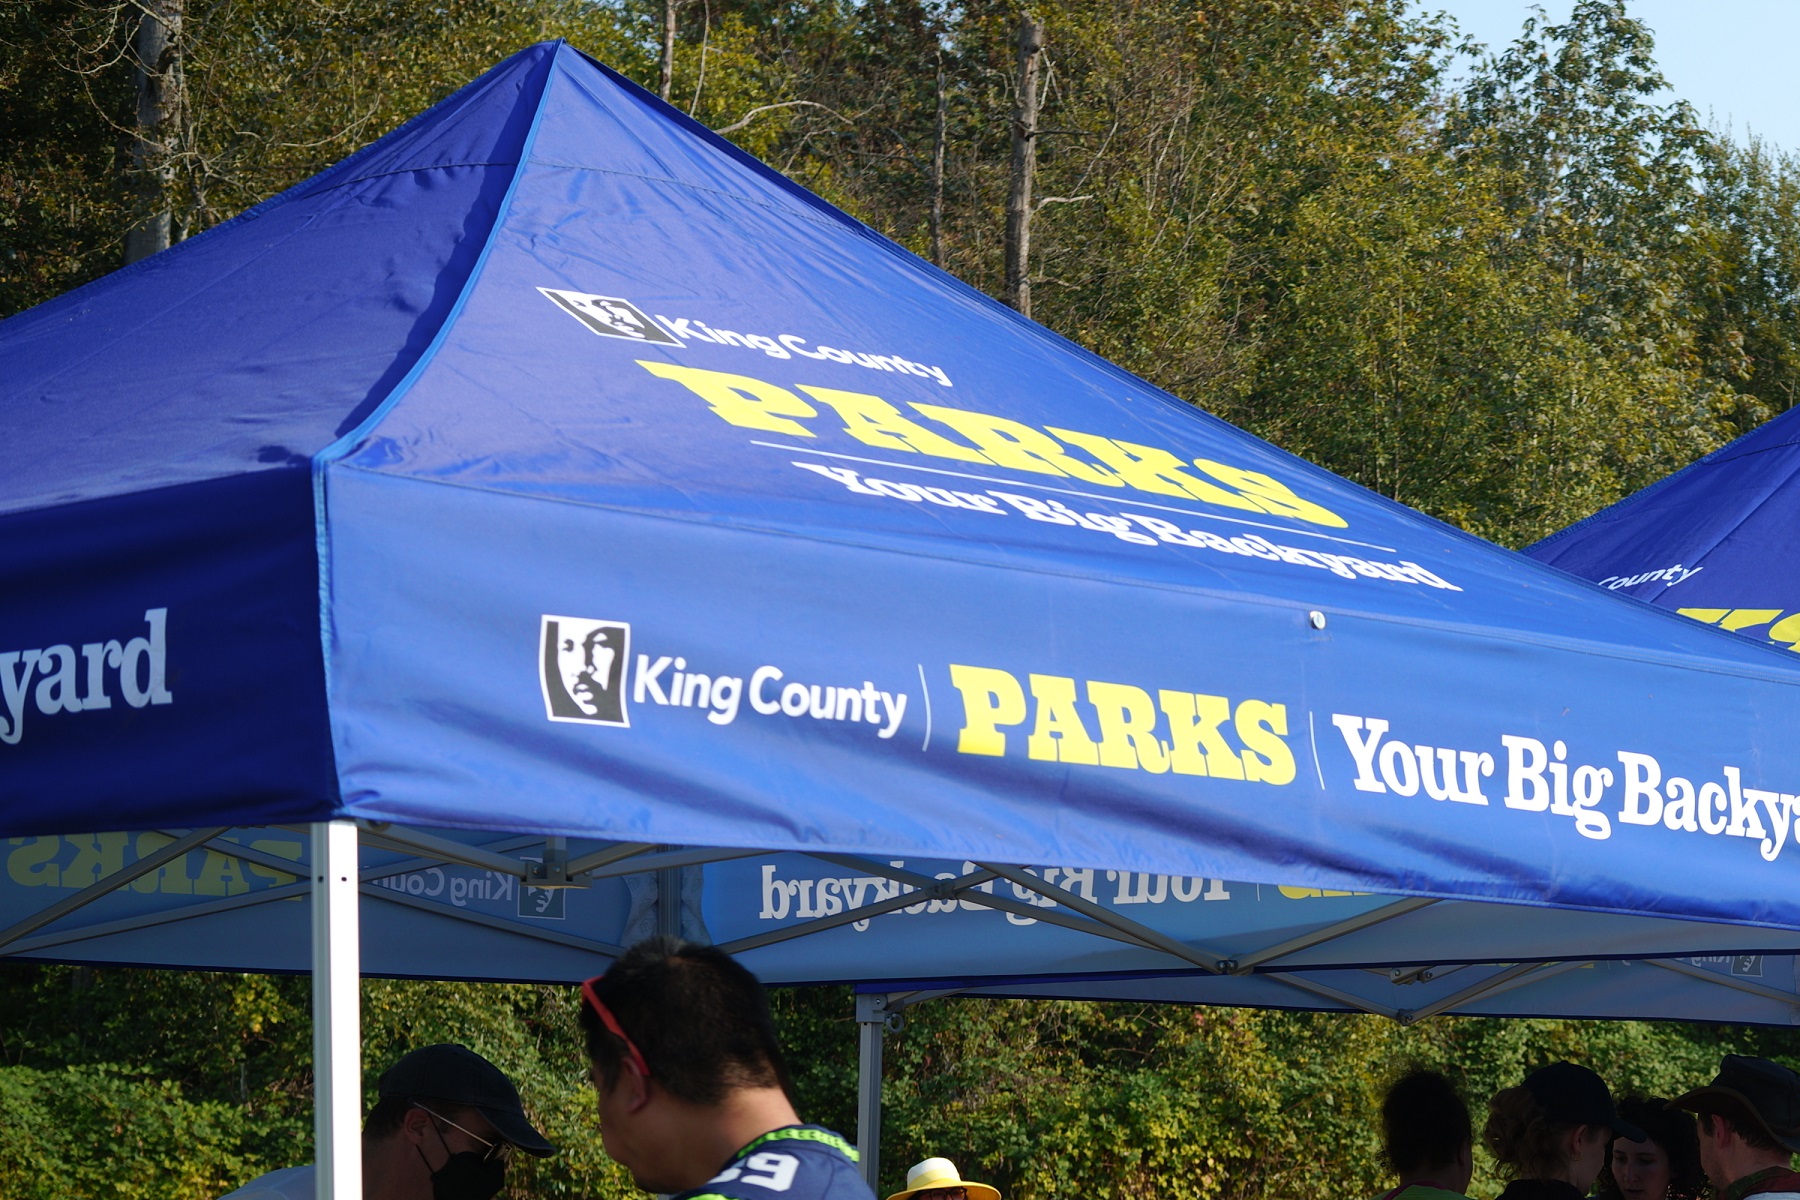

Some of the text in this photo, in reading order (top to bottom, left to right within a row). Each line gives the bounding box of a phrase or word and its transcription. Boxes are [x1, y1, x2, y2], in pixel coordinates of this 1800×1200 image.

[655, 314, 953, 388] King County
[634, 359, 1349, 528] PARKS
[791, 461, 1463, 592] Your Big Backyard
[633, 653, 743, 726] King
[749, 665, 908, 739] County
[949, 663, 1297, 786] PARKS
[1331, 713, 1495, 806] Your
[1501, 734, 1614, 841] Big
